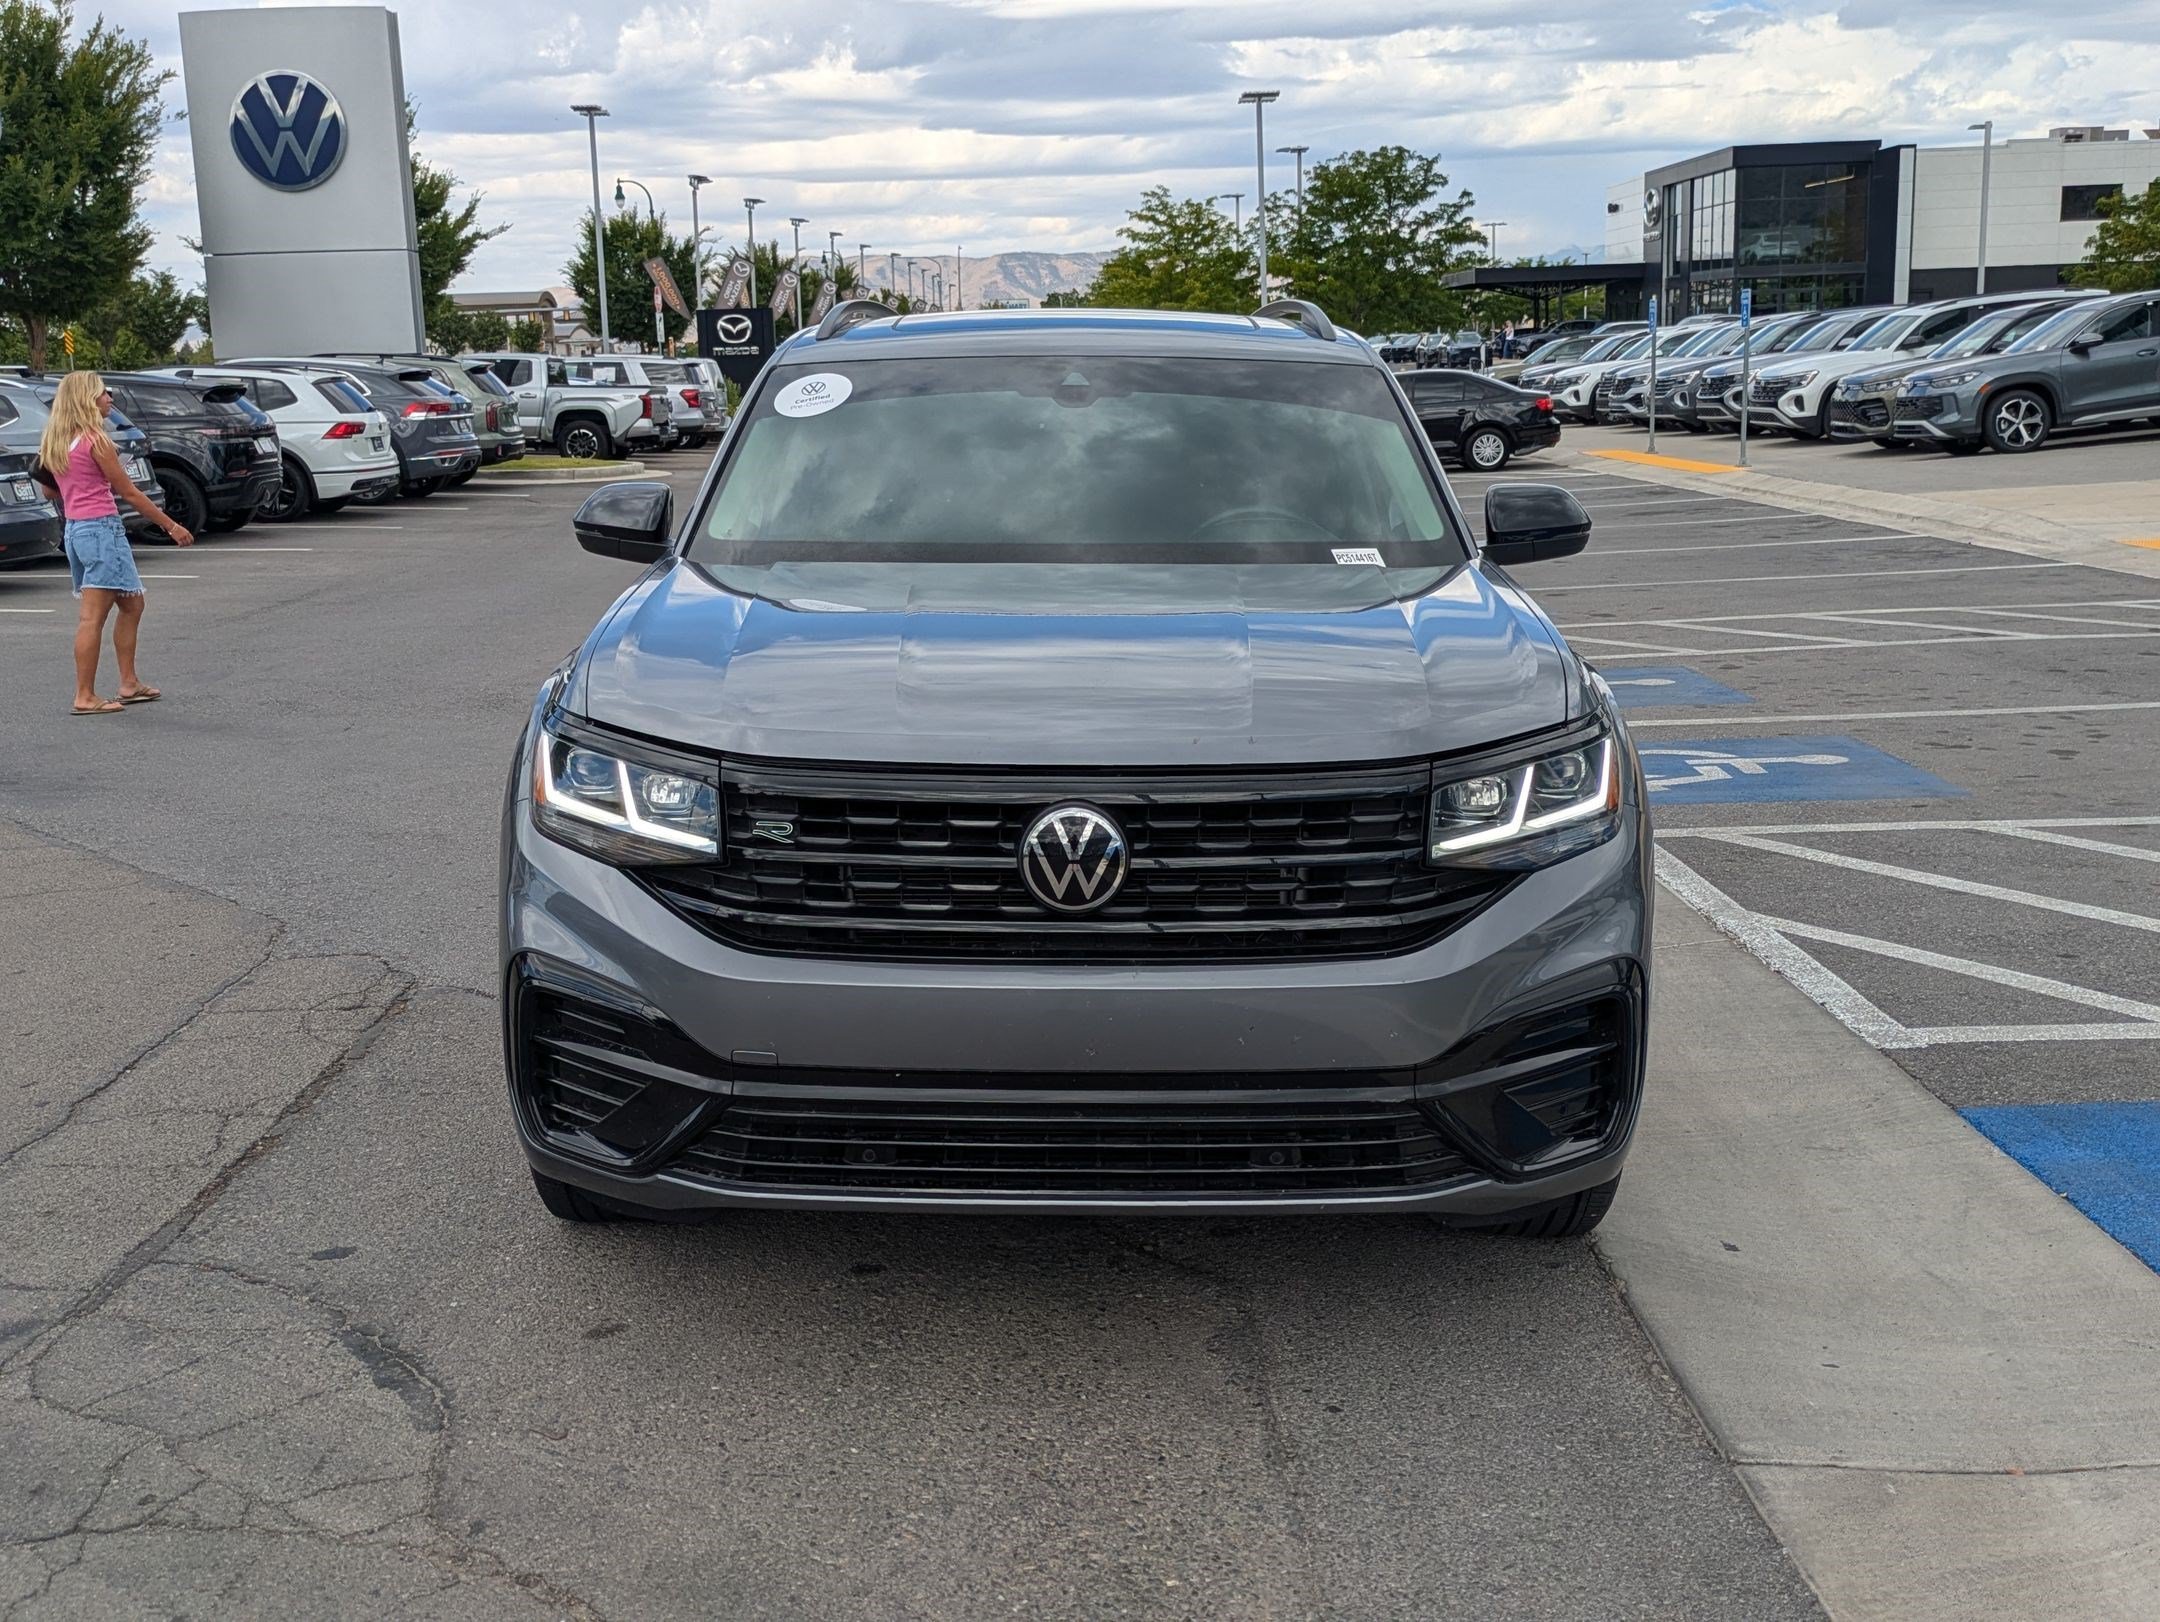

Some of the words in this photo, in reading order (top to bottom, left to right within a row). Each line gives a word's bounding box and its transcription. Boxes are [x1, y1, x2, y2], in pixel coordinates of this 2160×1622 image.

[727, 280, 743, 306] MAZDA
[790, 398, 834, 411] Pre-Owned
[794, 394, 831, 404] Certified
